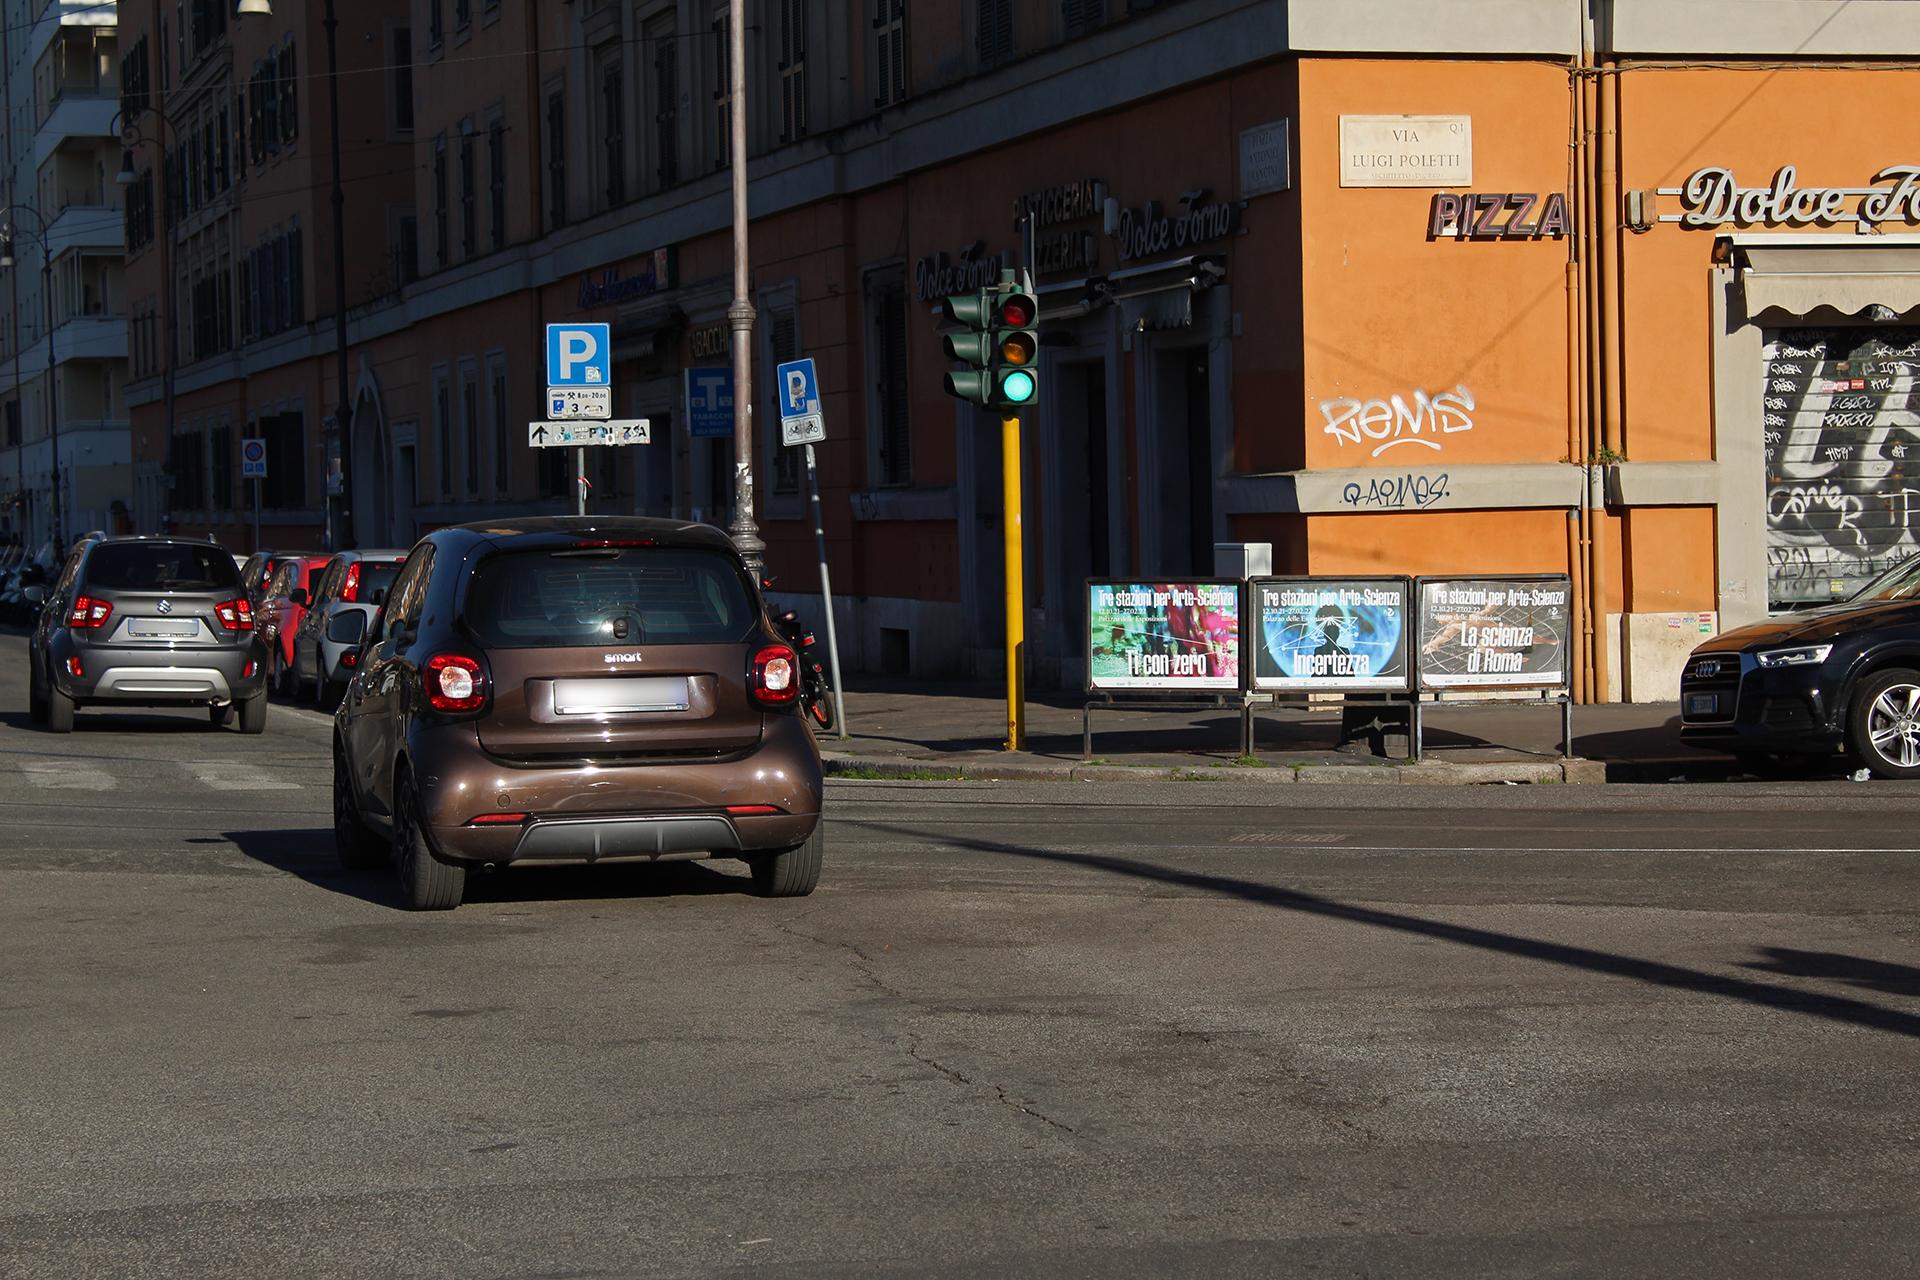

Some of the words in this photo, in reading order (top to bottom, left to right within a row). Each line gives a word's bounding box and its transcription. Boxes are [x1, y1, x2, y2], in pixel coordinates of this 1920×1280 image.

[1393, 130, 1419, 142] VIA
[1353, 154, 1393, 167] LUIGI
[1400, 154, 1460, 167] POLETTI
[1687, 166, 1846, 225] Dolce
[1119, 199, 1169, 261] Dolce
[1174, 188, 1231, 248] Forno
[1432, 192, 1570, 236] PIZZA
[915, 252, 954, 302] Dolce
[956, 243, 997, 292] Forno
[560, 331, 597, 379] P
[1099, 590, 1114, 606] Tre
[1115, 588, 1152, 607] stazioni
[1154, 591, 1171, 608] per
[1173, 589, 1234, 607] Arte-Scienza
[1262, 589, 1279, 606] Tre
[1281, 588, 1318, 607] stazioni
[1320, 592, 1338, 608] per
[1340, 589, 1400, 607] Arte-Scienza
[1432, 588, 1447, 604] Tre
[1449, 588, 1487, 605] stazioni
[1488, 590, 1506, 607] per
[1507, 588, 1565, 606] Arte-Scienza
[1461, 621, 1477, 646] La
[1481, 622, 1533, 646] scienza
[604, 651, 642, 663] smart
[1126, 649, 1140, 675] Ti
[1143, 654, 1169, 675] con
[1174, 654, 1207, 675] zero
[1293, 650, 1370, 676] Incertezza
[1467, 649, 1481, 672] di
[1484, 648, 1523, 672] Roma
